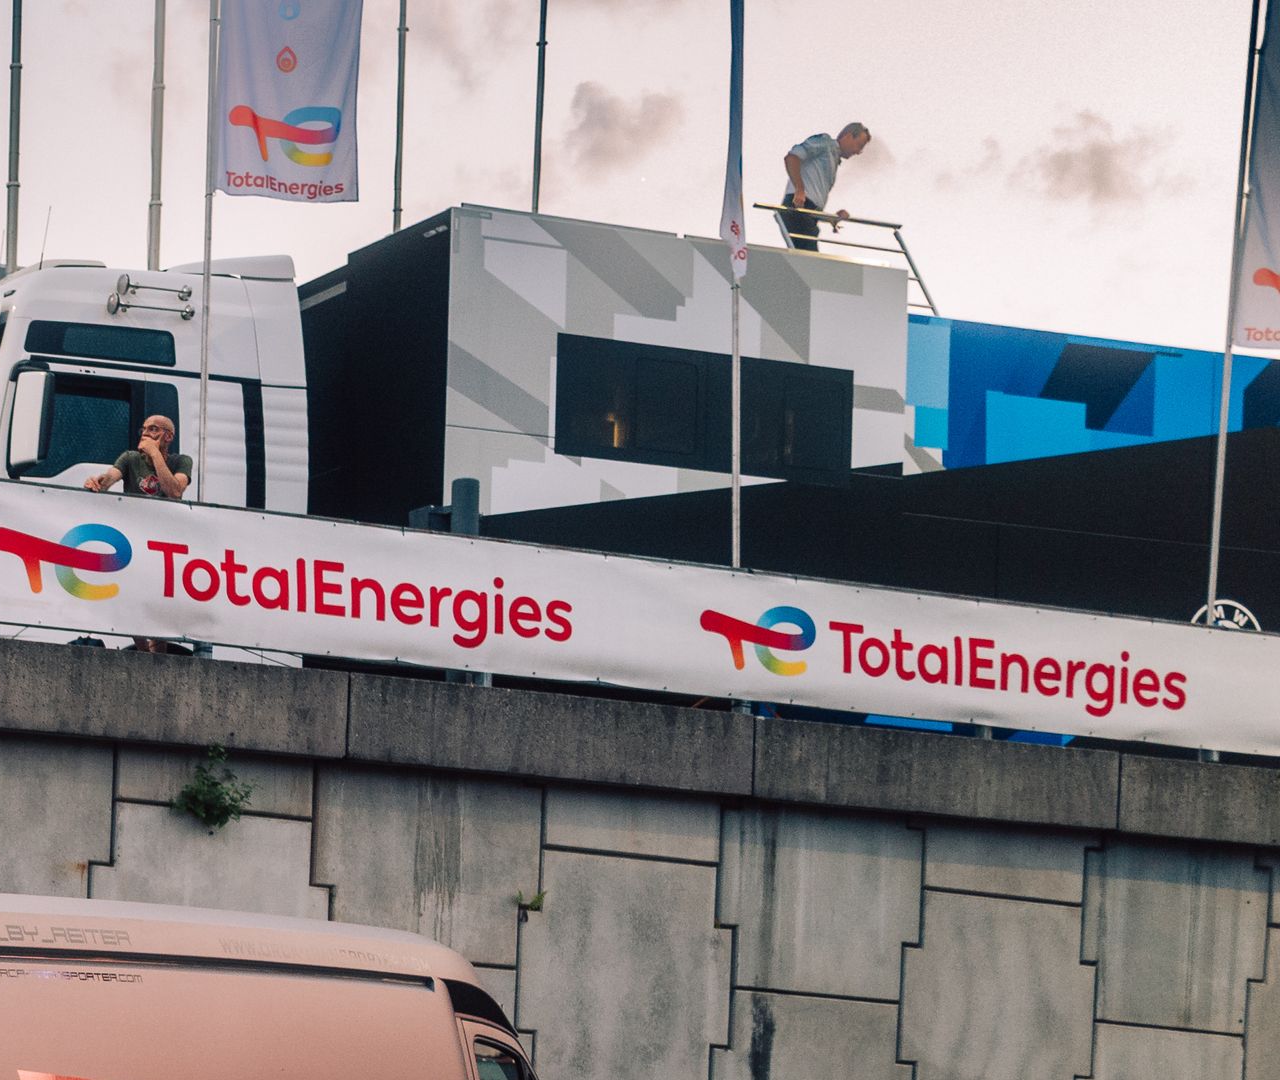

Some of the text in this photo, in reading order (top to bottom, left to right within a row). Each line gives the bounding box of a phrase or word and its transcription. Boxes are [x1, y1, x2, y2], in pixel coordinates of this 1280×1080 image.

[226, 171, 344, 200] TotalEnergies
[147, 541, 573, 652] TotalEnergies
[829, 620, 1188, 717] TotalEnergies
